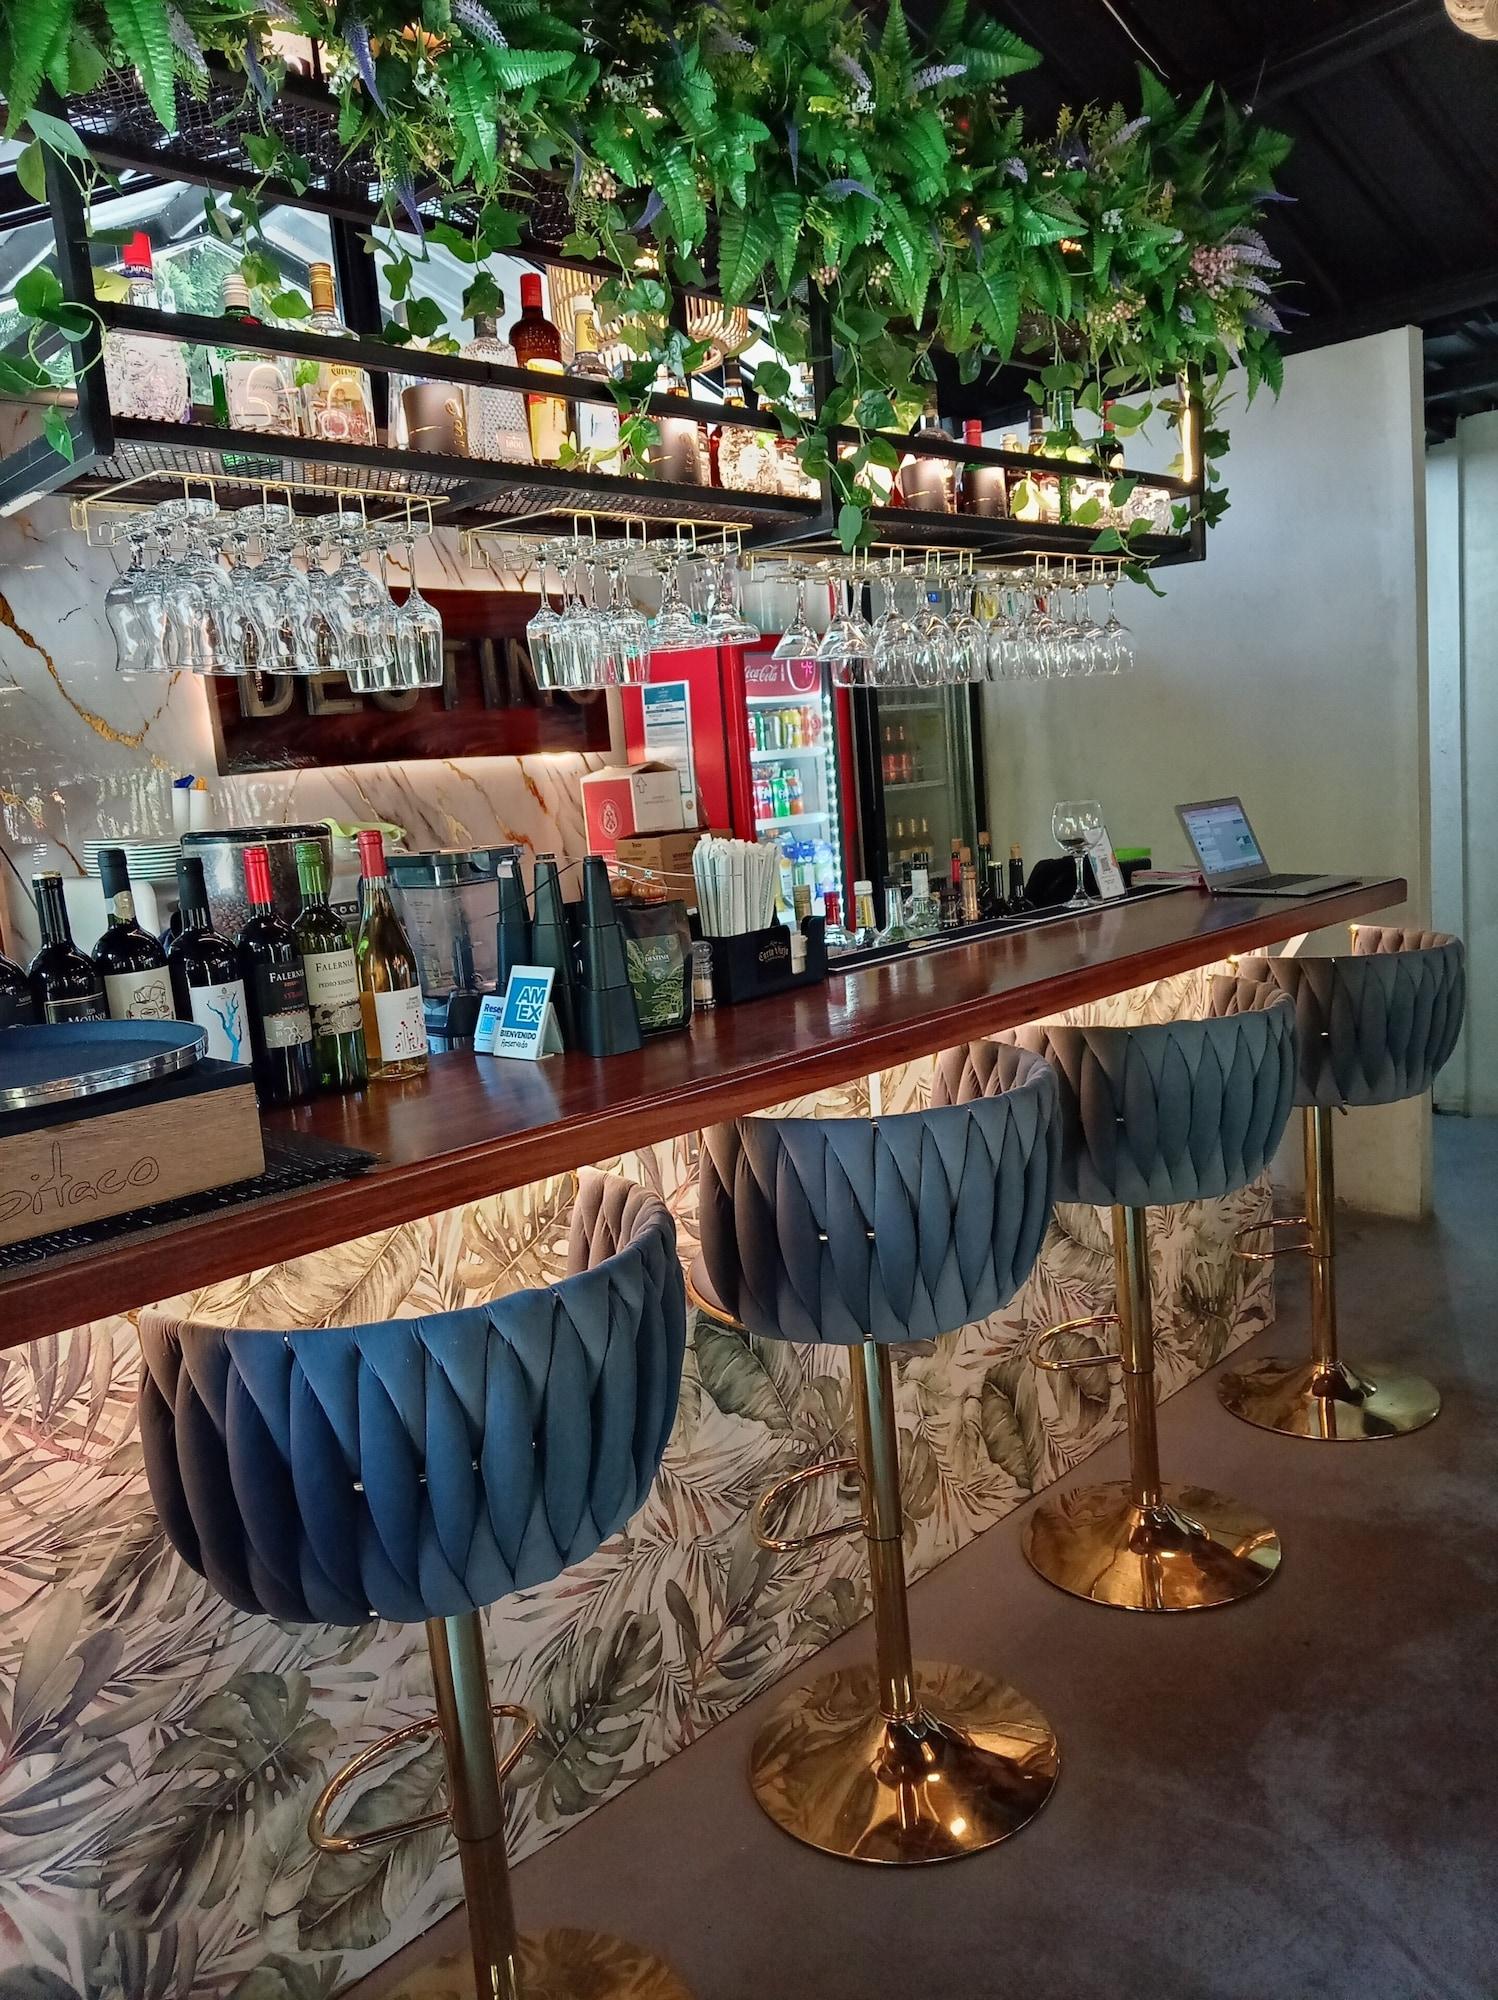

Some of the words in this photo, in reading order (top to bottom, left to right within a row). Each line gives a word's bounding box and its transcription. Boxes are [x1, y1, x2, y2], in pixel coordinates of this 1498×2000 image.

[516, 986, 547, 1005] AM
[517, 1004, 543, 1023] EX
[500, 1029, 537, 1039] BIENVENIDO
